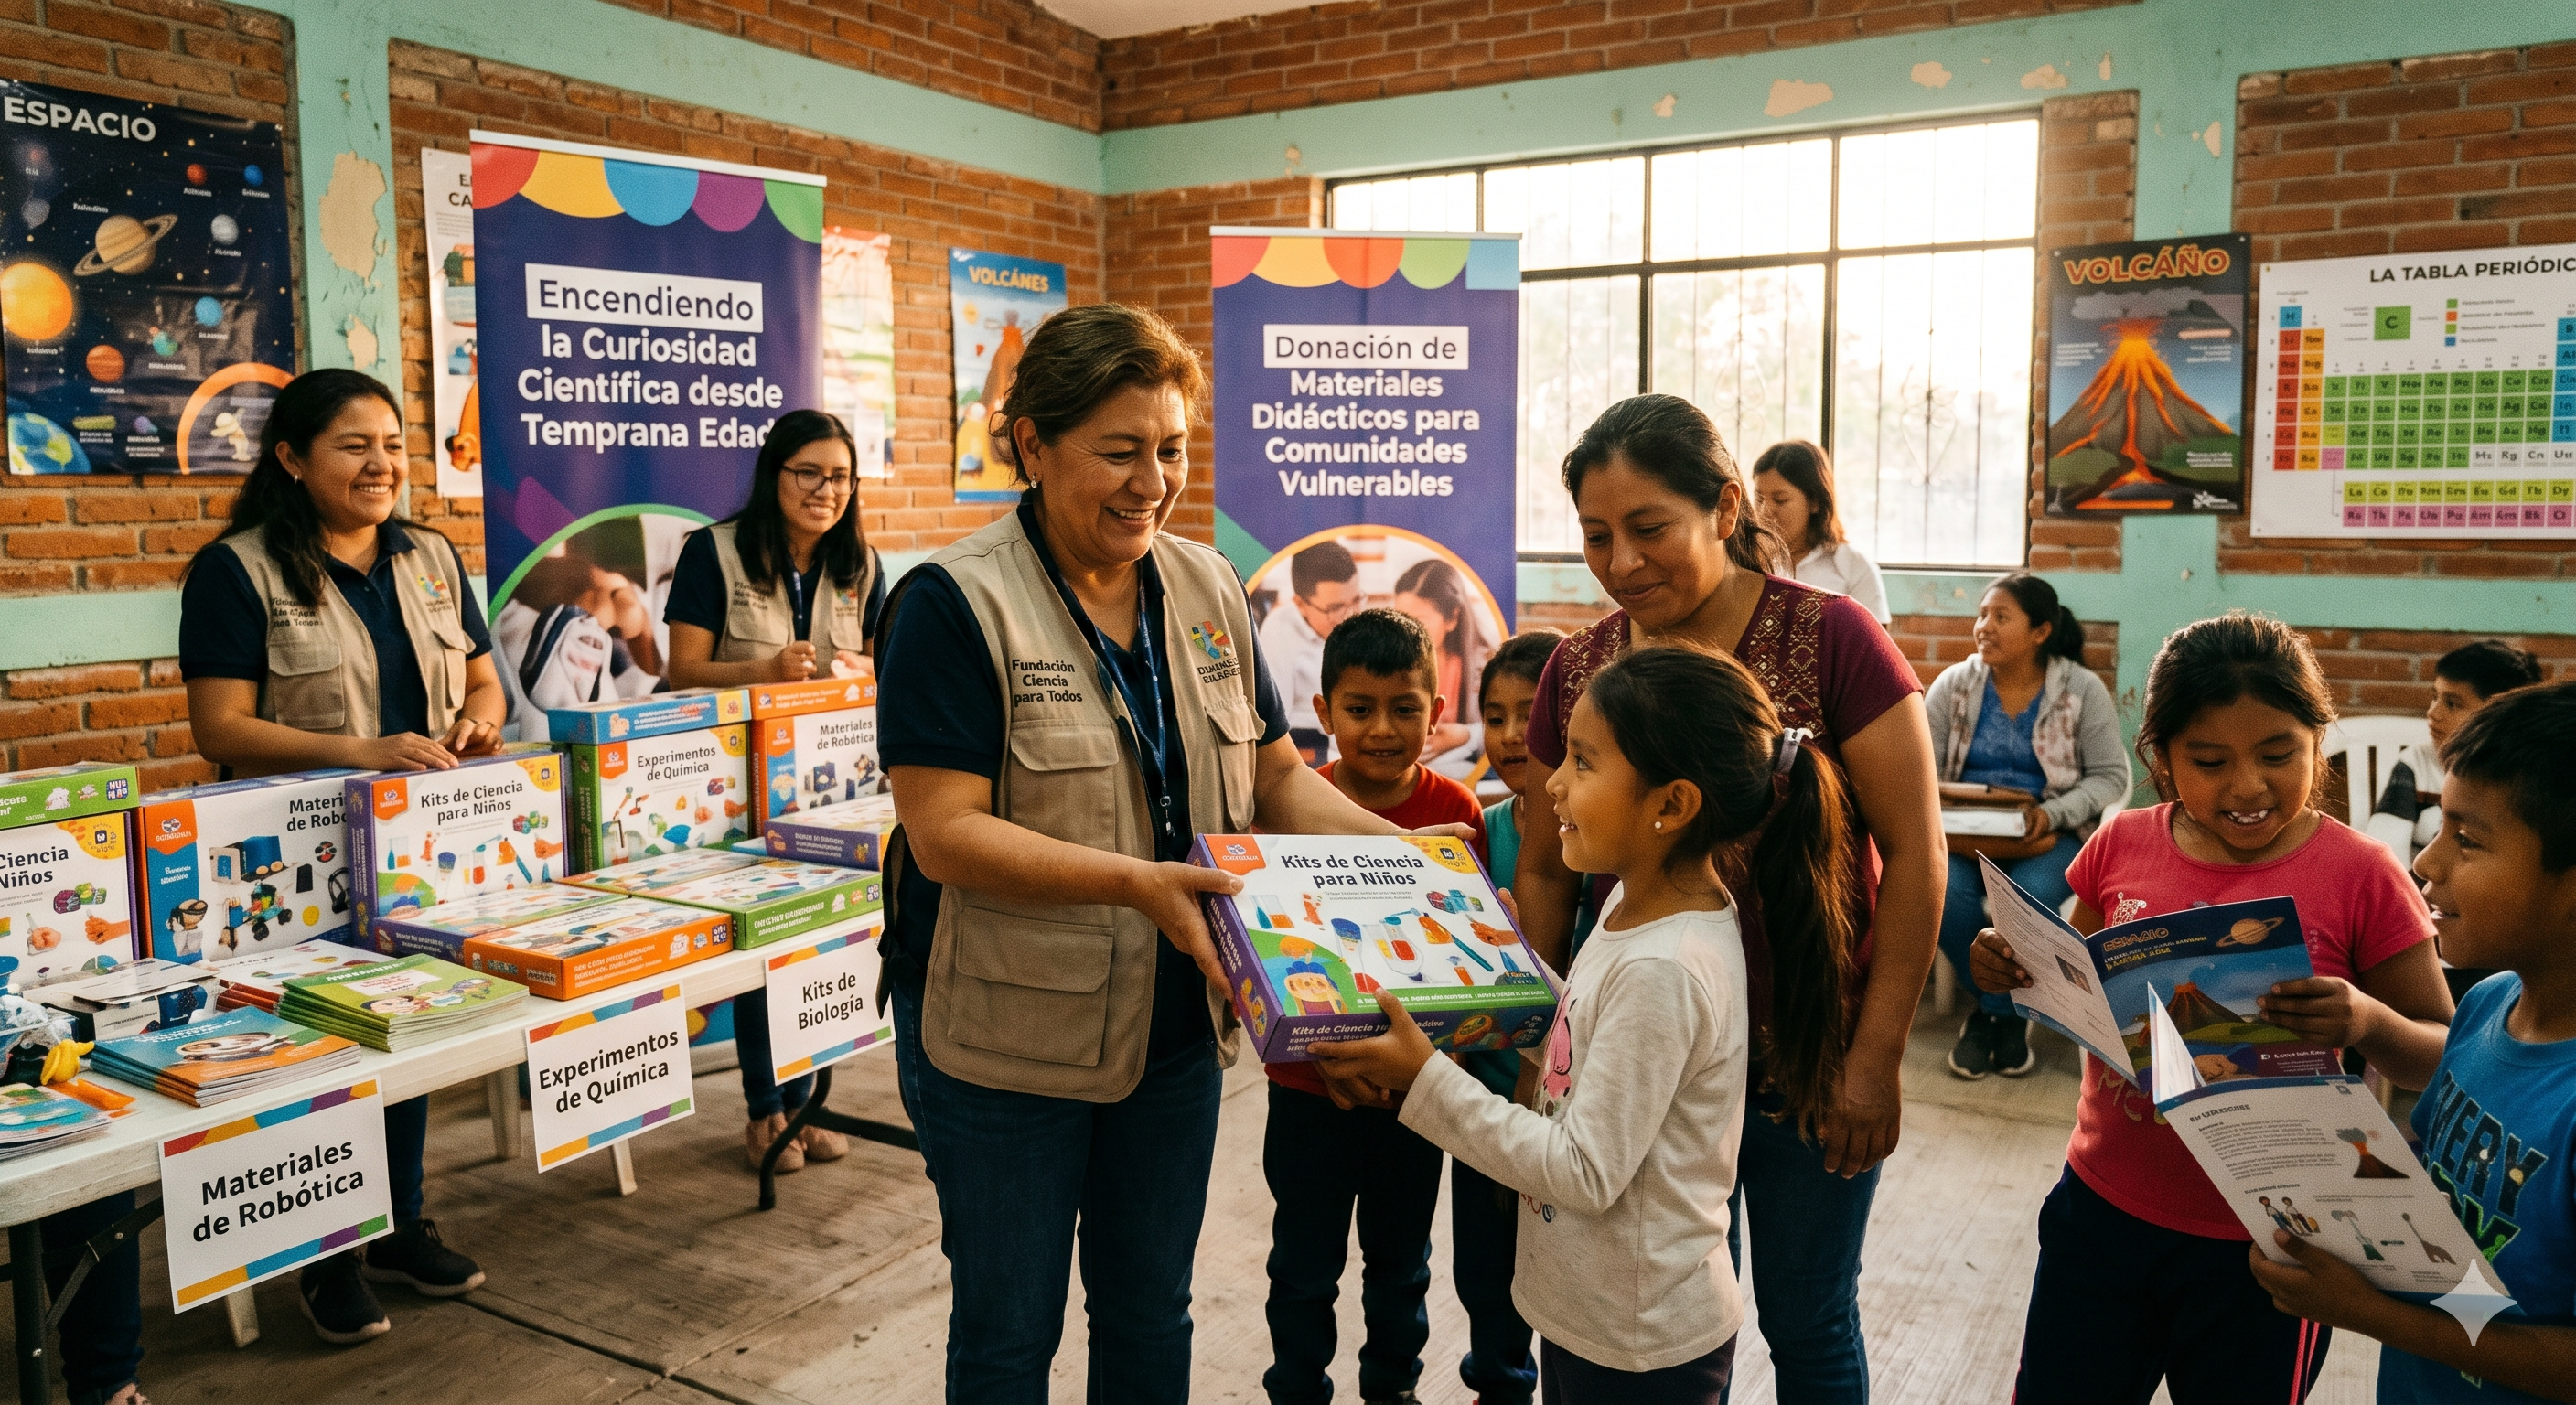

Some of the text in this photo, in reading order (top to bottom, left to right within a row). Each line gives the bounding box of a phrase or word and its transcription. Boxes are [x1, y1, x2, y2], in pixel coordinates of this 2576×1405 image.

[4, 95, 156, 142] ESPACIO
[459, 173, 473, 188] E
[968, 265, 1049, 293] VOLCÁNES
[2370, 268, 2396, 283] LA
[2401, 264, 2469, 281] TABLA
[539, 279, 754, 321] Encendiendo
[542, 324, 757, 367] la Curiosidad
[1275, 334, 1457, 359] Donación de
[688, 374, 784, 409] desde
[1290, 369, 1444, 397] Materiales
[1251, 401, 1481, 436] Didácticos para
[521, 413, 776, 454] Temprana Edad
[1265, 434, 1469, 464] Comunidades
[1278, 468, 1454, 497] Vulnerables
[1012, 659, 1075, 672] Fundación
[1023, 674, 1068, 686] Ciencia
[1014, 690, 1083, 707] para Todos
[820, 719, 873, 735] Materiales
[817, 734, 875, 750] de Robótica
[638, 746, 716, 769] Experimentos
[647, 768, 660, 781] de
[421, 781, 523, 809] Kits de Ciencia
[287, 817, 306, 831] de
[437, 798, 511, 826] para Niños
[1281, 854, 1424, 869] Kits de Ciencia
[1313, 872, 1417, 889] para Niños
[802, 972, 856, 1003] Kits de
[798, 993, 864, 1030] Biología
[539, 1031, 679, 1090] Experimentos
[556, 1061, 669, 1113] de Química
[201, 1142, 354, 1206] Materiales
[193, 1171, 364, 1242] de Robótica
